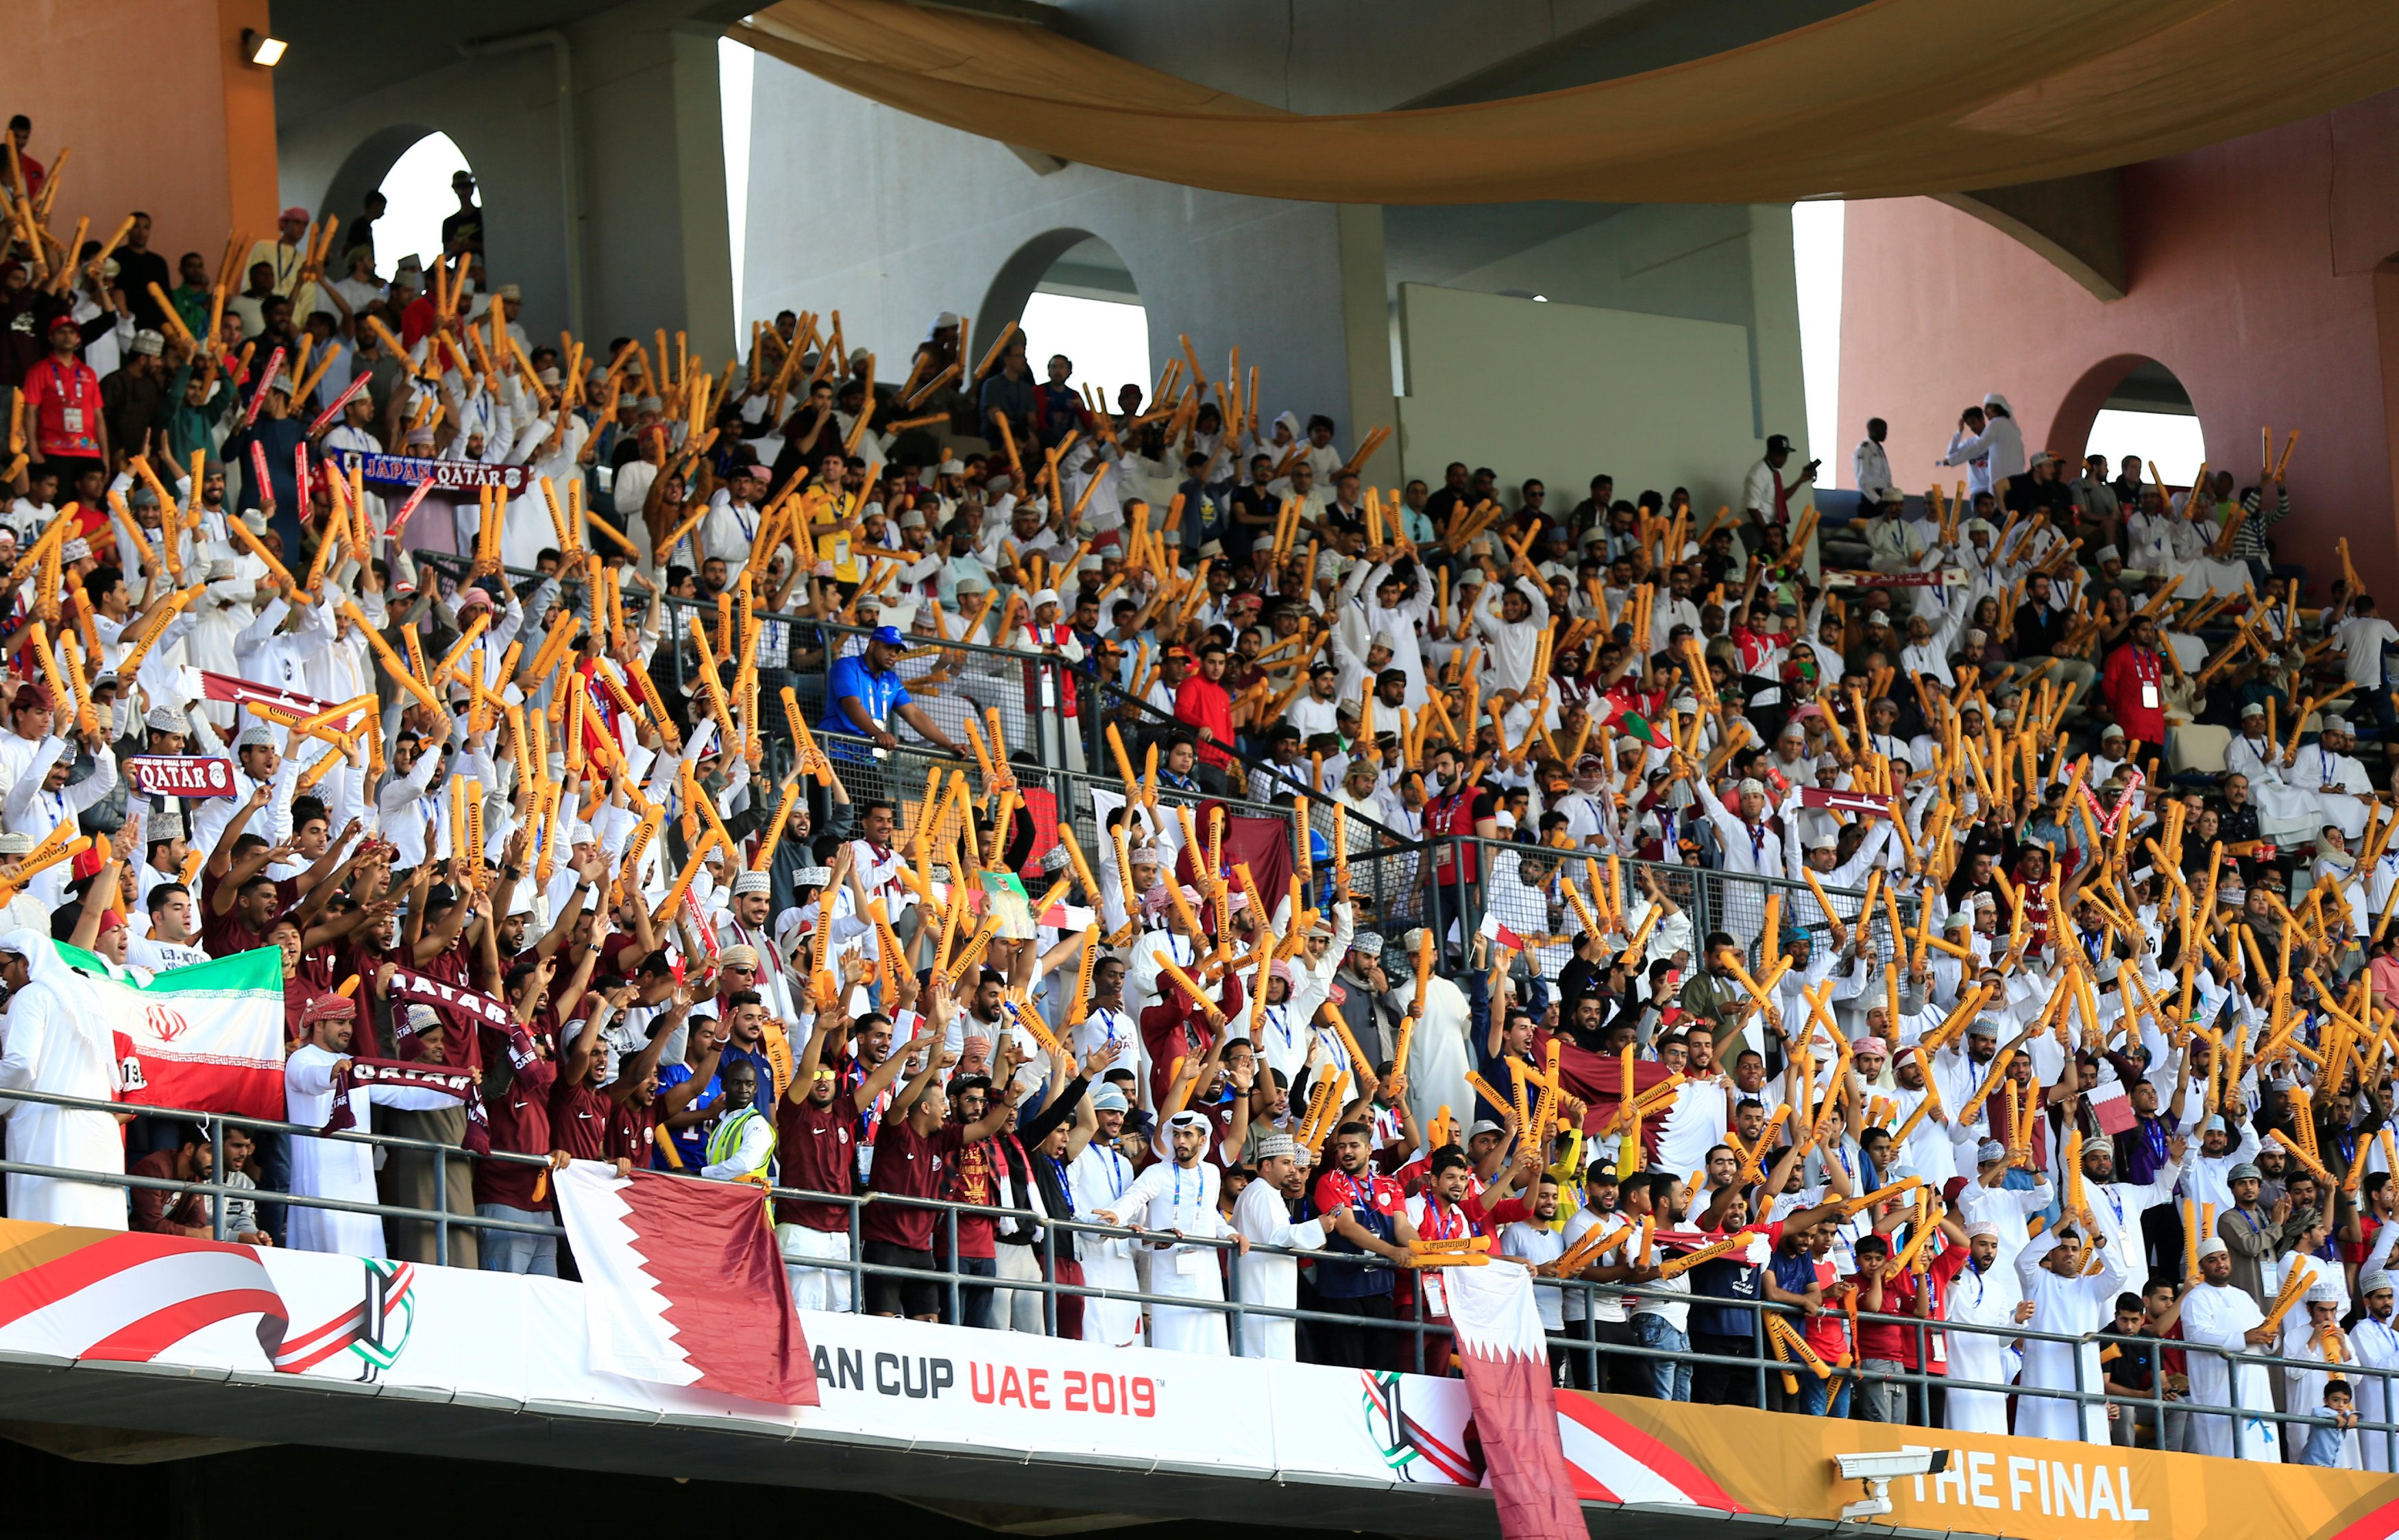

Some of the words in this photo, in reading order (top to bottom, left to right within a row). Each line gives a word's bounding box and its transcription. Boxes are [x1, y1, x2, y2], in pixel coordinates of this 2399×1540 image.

[365, 459, 432, 480] JAPAN
[437, 466, 501, 487] QATAR
[139, 604, 177, 652] Continental
[64, 647, 82, 699] Continental
[602, 672, 636, 717] Continental
[640, 681, 667, 722] Continental
[745, 683, 753, 729] Continental
[786, 702, 806, 747] Continental
[989, 720, 1002, 761] Continental
[140, 765, 207, 790] QATAR
[541, 797, 552, 845] Continental
[914, 783, 931, 830] Continental
[927, 785, 953, 831] Continental
[470, 803, 480, 858] Continental
[1210, 822, 1218, 868] Continental
[1296, 811, 1305, 855] Continental
[1934, 815, 1949, 853] Continental
[1112, 835, 1126, 882] Continental
[1217, 901, 1228, 942] Continental
[2089, 898, 2123, 929] Continental
[2105, 886, 2130, 921] Continental
[814, 911, 829, 966] Continental
[953, 928, 991, 974] Continental
[1937, 995, 1969, 1032] Continental
[1474, 1076, 1506, 1105] Continental
[1973, 1060, 2003, 1101] Continental
[1301, 1081, 1326, 1132] Continental
[1530, 1085, 1550, 1136] Continental
[2006, 1094, 2014, 1138] Continental
[2291, 1103, 2305, 1144] Continental
[2302, 1107, 2314, 1150] Continental
[1755, 1121, 1781, 1163] Continental
[1429, 1238, 1470, 1249] Continental
[1685, 1238, 1736, 1265] Continental
[1778, 1323, 1818, 1365] Continental
[875, 1352, 953, 1400] CUP
[969, 1361, 1051, 1410] UAE
[1064, 1371, 1156, 1418] 2019
[2008, 1455, 2150, 1521] FINAL
